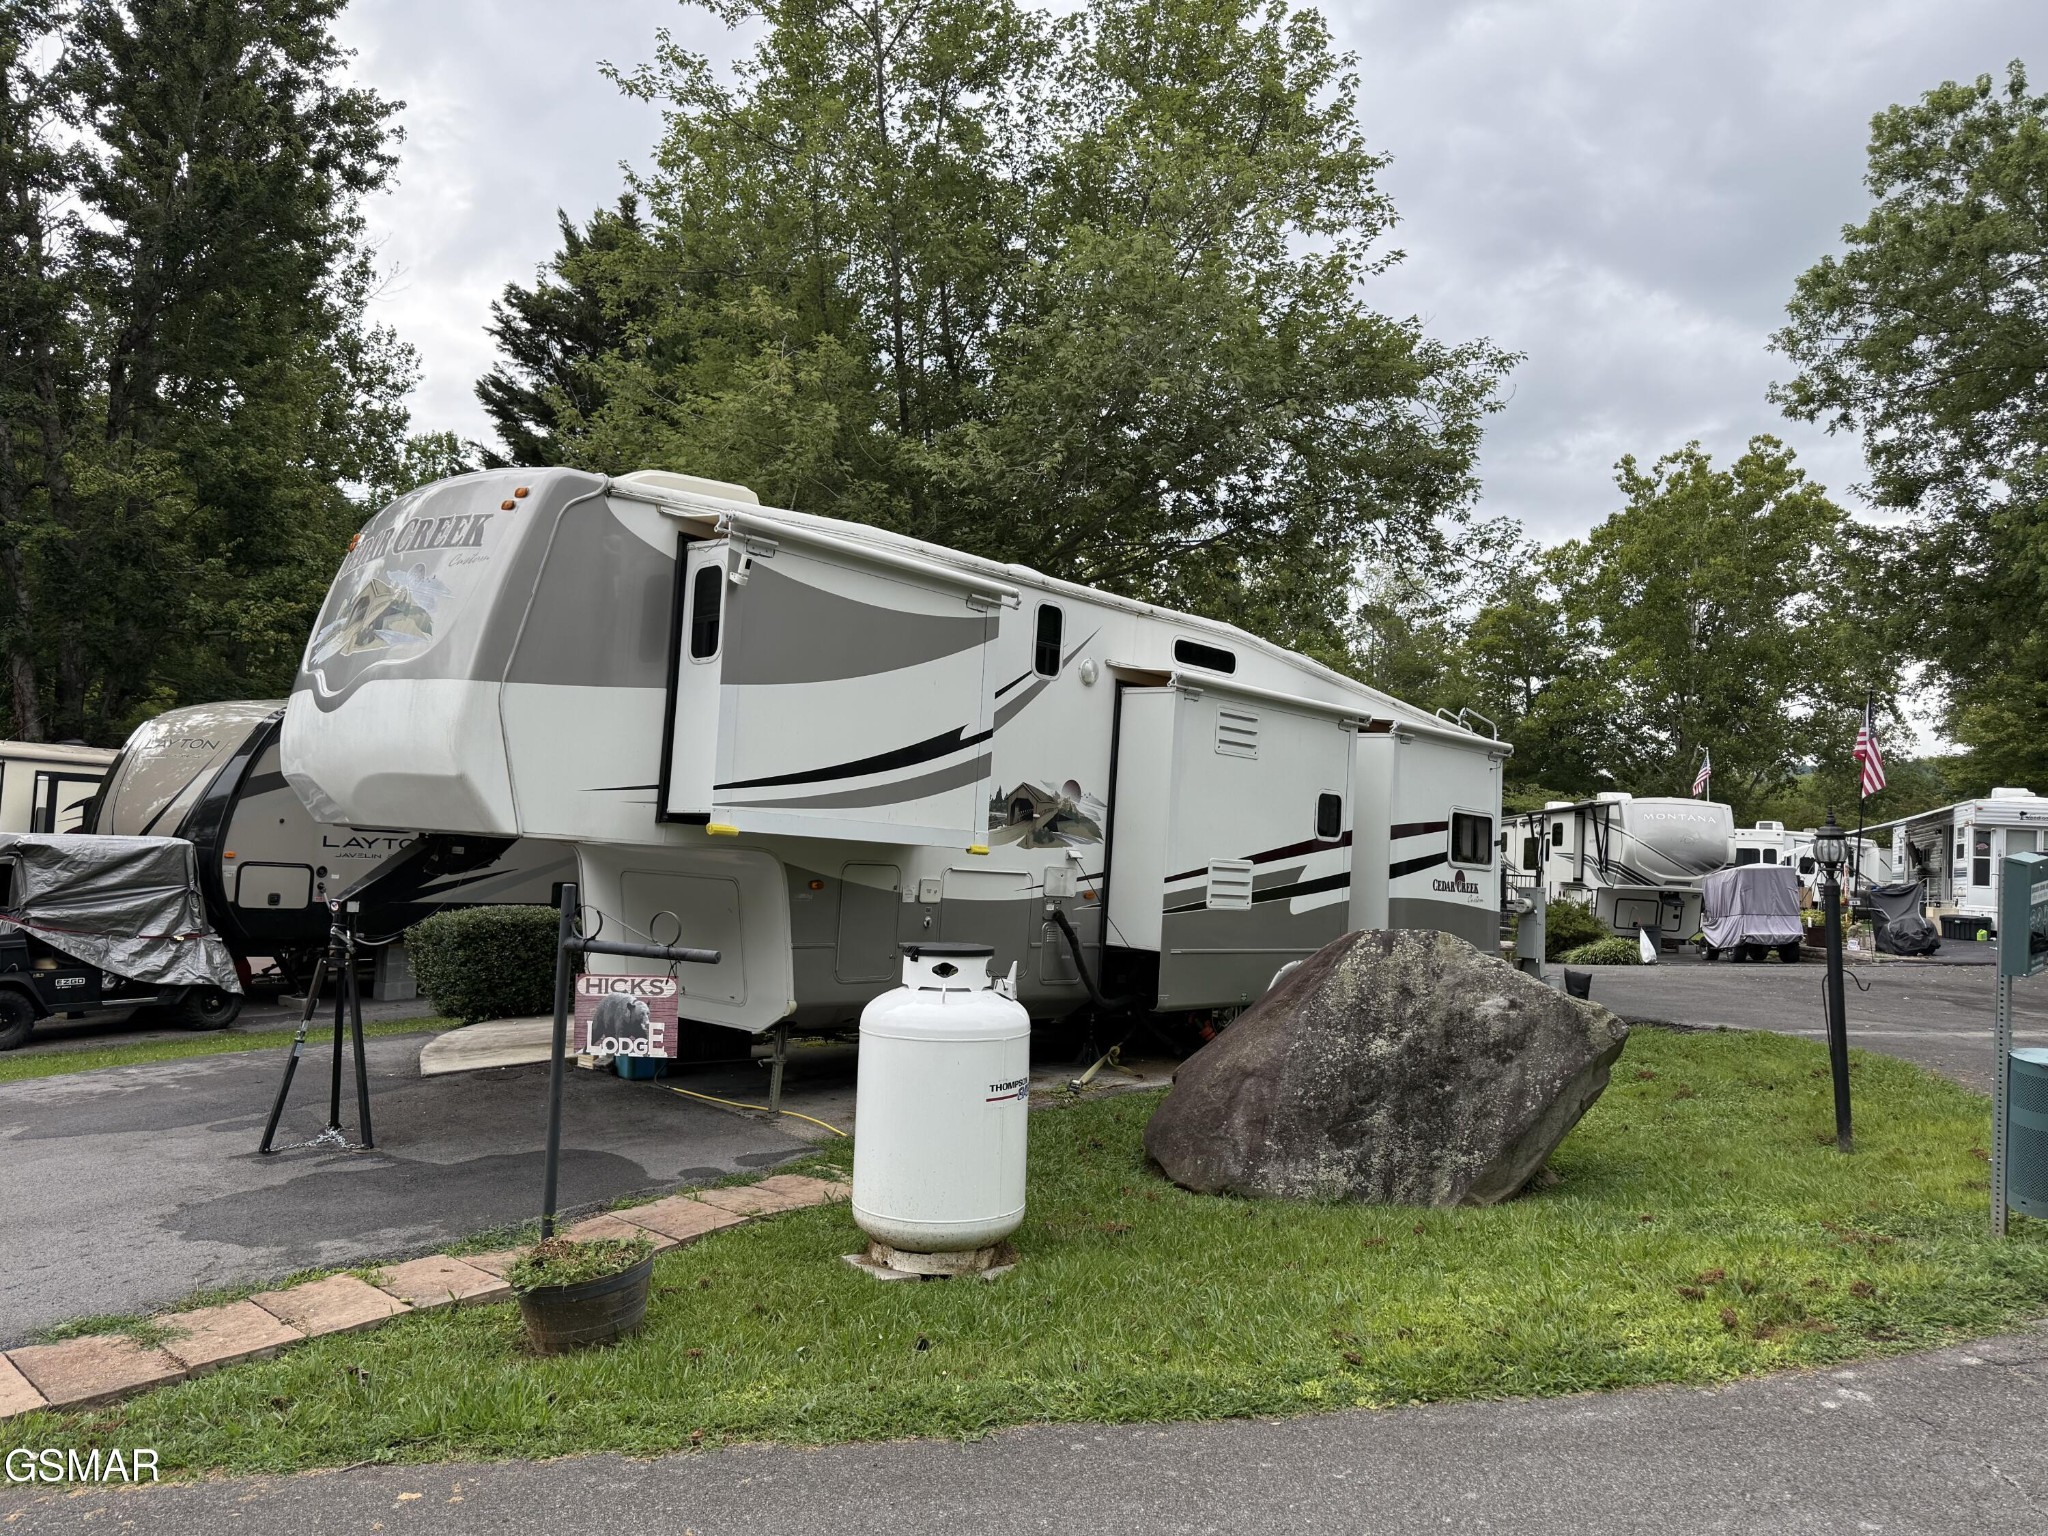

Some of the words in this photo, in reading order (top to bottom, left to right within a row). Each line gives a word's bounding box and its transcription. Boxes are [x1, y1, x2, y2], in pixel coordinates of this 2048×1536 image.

[392, 513, 494, 555] CREEK
[142, 738, 220, 750] LAYTON
[1643, 813, 1717, 824] MONTANA
[1432, 878, 1455, 893] CEDAR
[1456, 880, 1479, 894] CREEK
[585, 977, 665, 996] HICKS
[586, 1020, 667, 1057] LODGE
